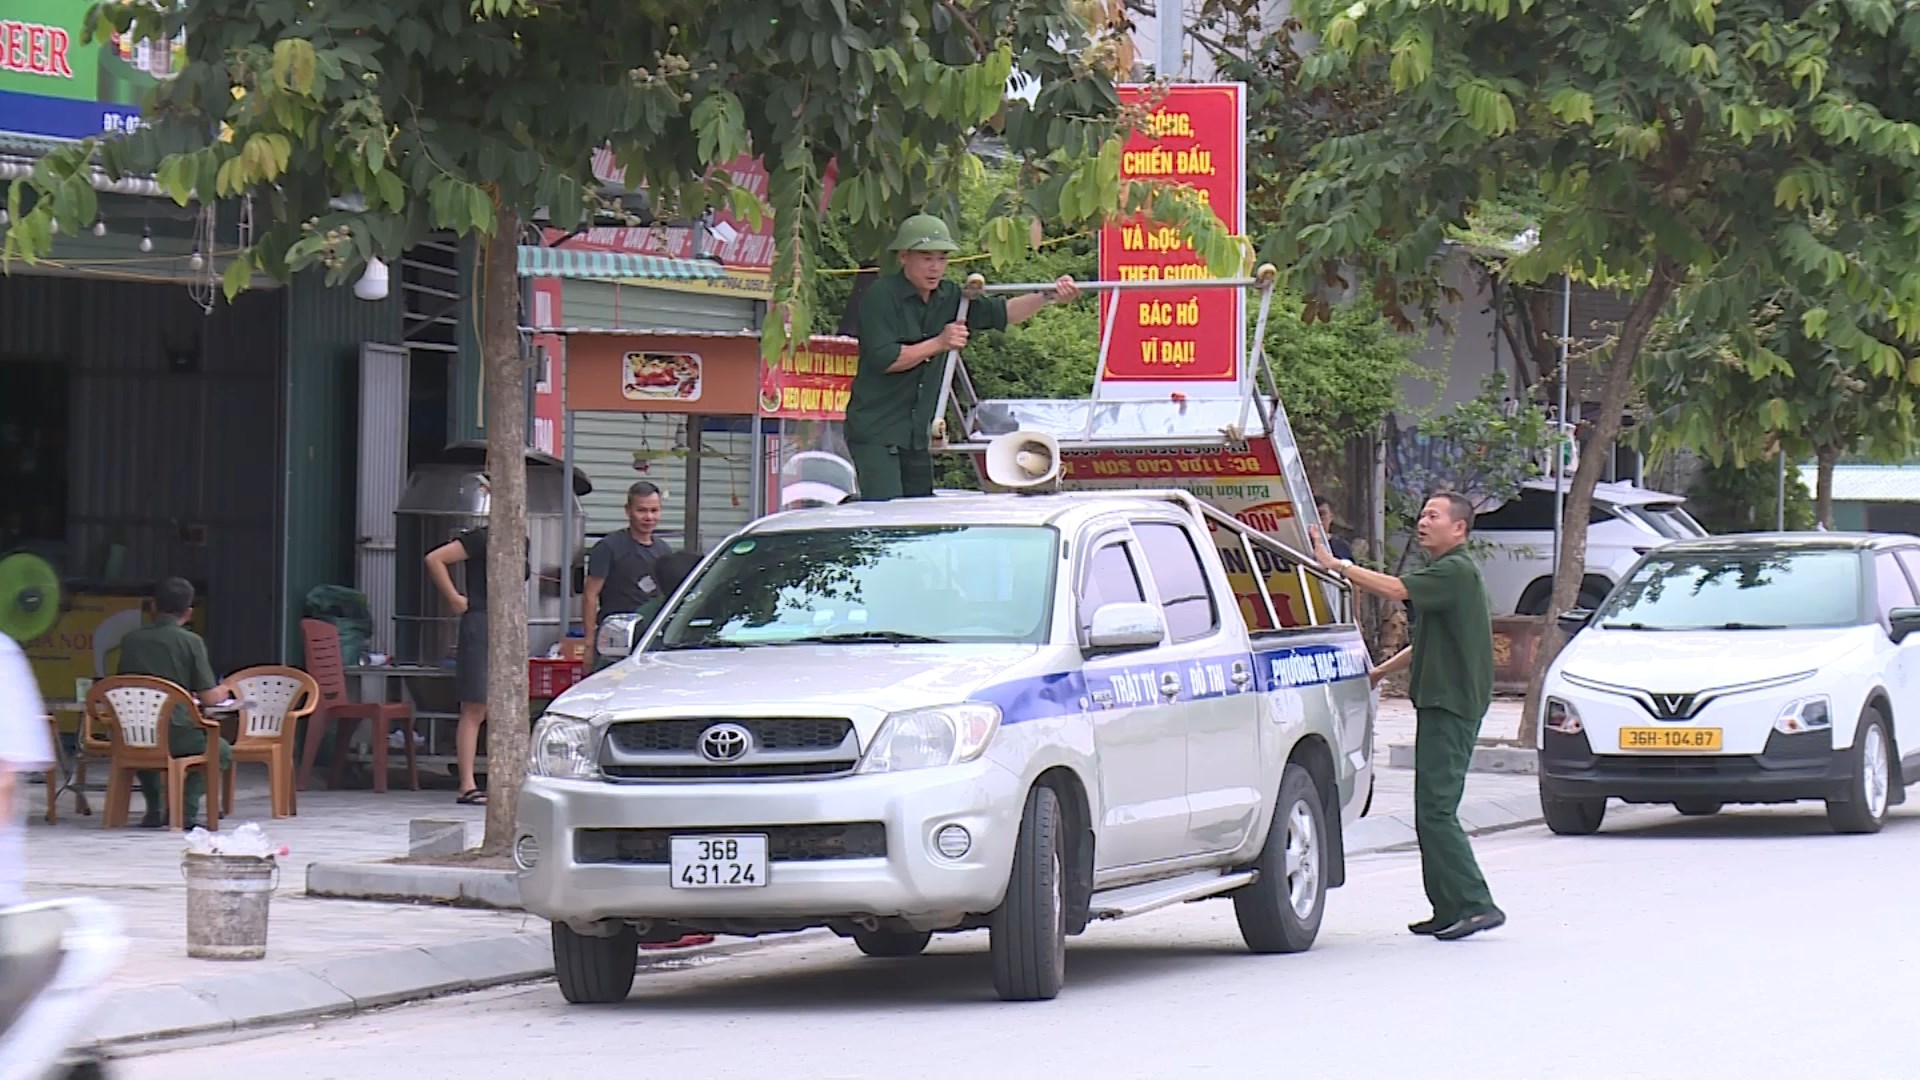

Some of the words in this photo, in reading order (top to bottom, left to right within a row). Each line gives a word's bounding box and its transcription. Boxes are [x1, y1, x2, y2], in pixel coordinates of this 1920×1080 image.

[0, 20, 72, 78] EER
[1123, 144, 1173, 175] CHIẾN
[1176, 143, 1216, 176] ĐẤU,
[1139, 299, 1172, 326] BÁC
[1141, 337, 1158, 363] VĨ
[1161, 340, 1195, 367] ĐẠI!
[1136, 458, 1170, 473] CAO
[1110, 668, 1142, 707] TRẬT
[1629, 730, 1714, 746] 36H-104.87
[698, 840, 738, 861] 36B
[682, 863, 755, 885] 431.24
